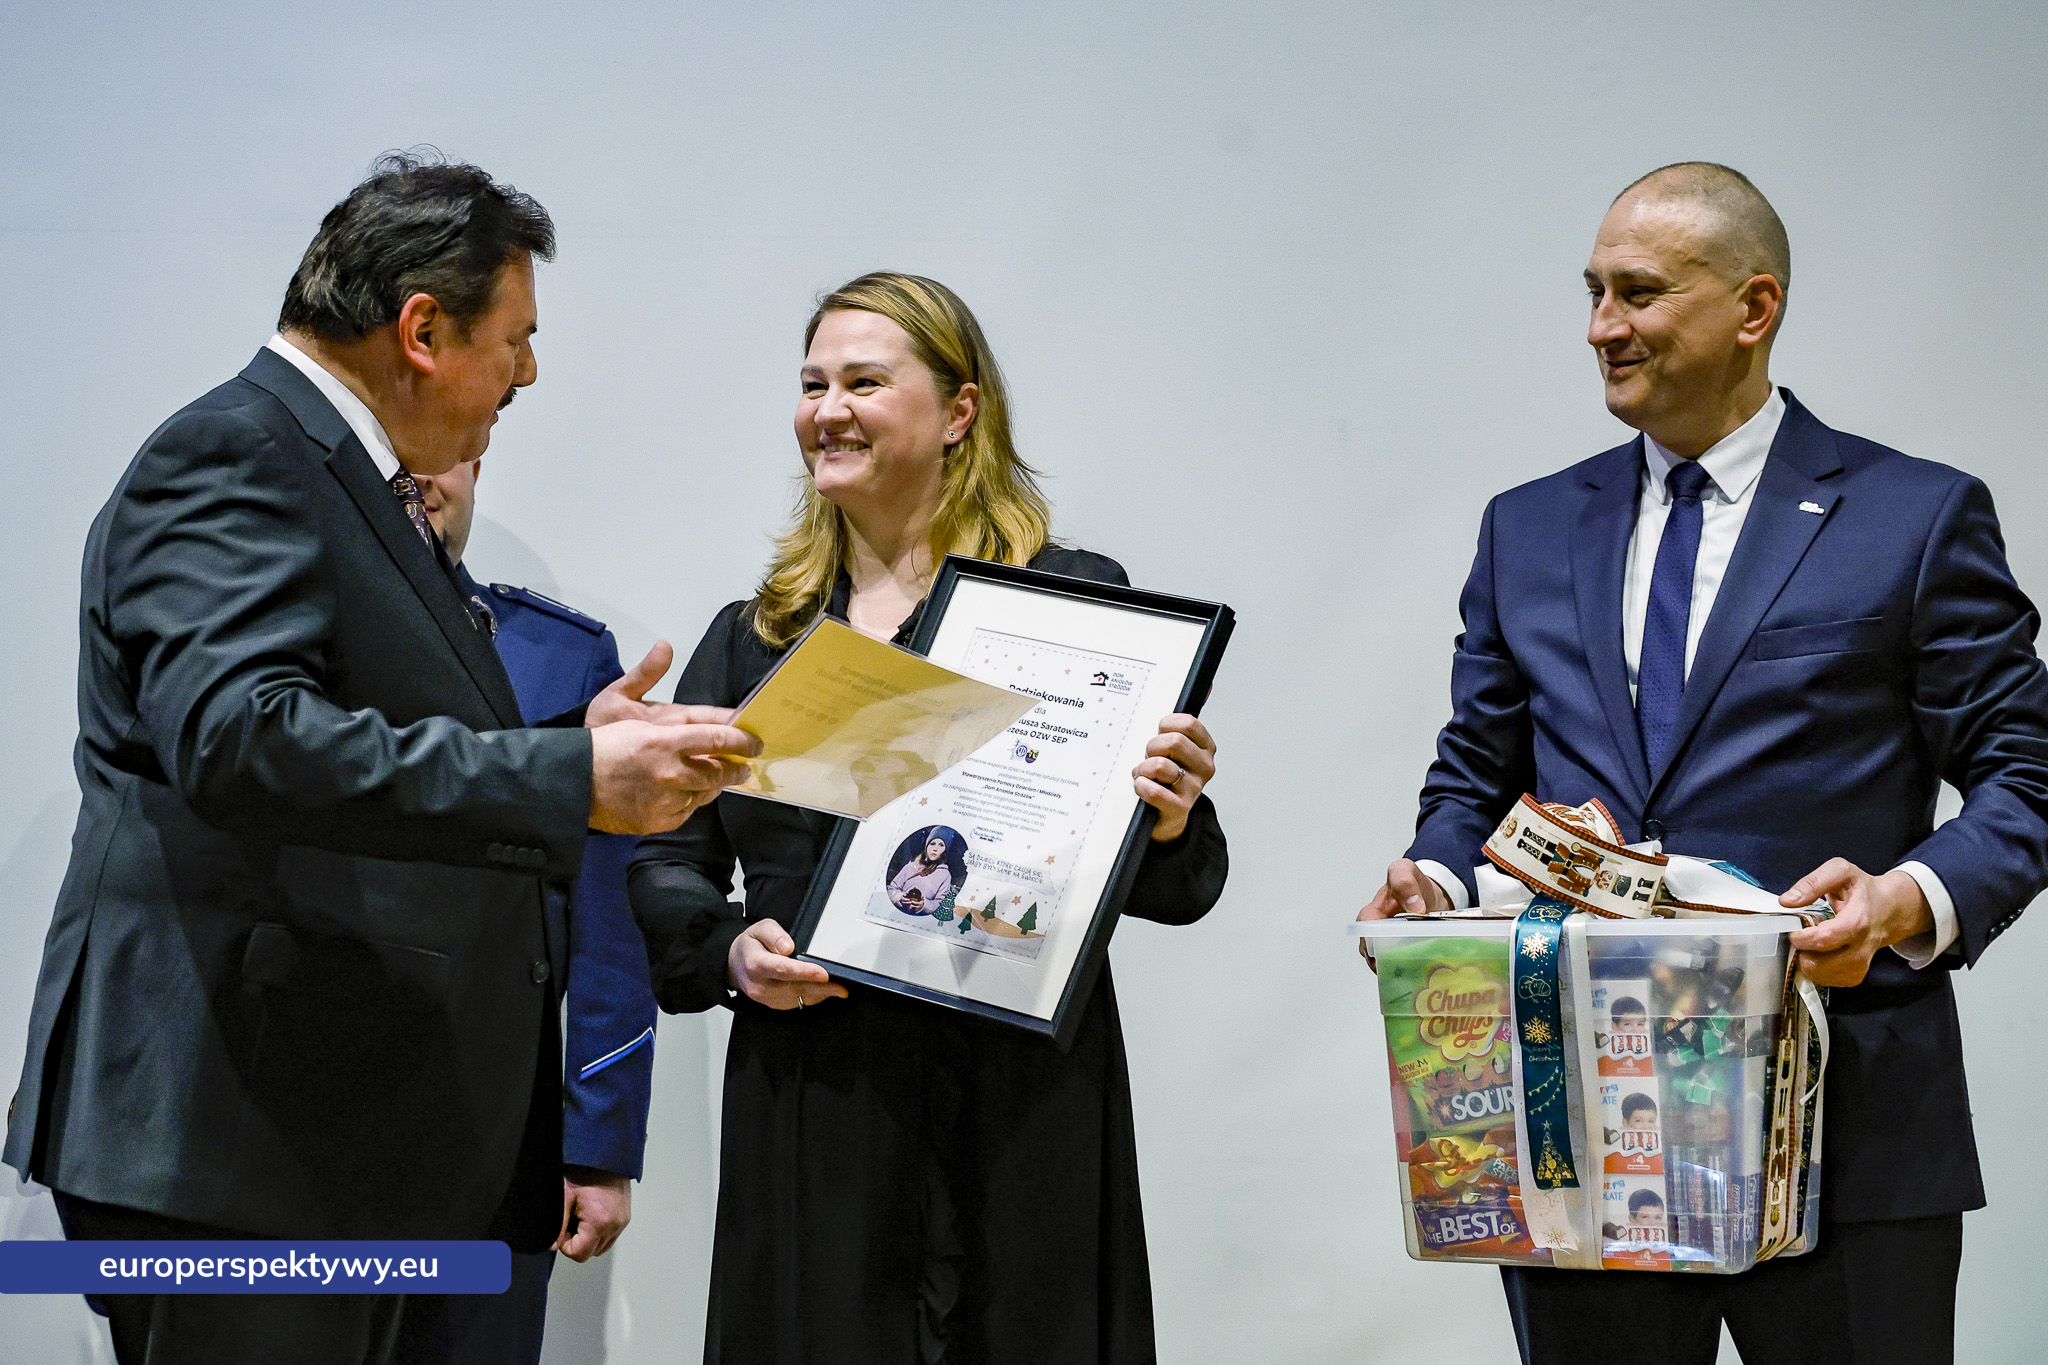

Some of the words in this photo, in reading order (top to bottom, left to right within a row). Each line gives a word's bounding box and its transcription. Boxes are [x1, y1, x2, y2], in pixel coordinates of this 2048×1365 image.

[1034, 706, 1047, 716] dla
[1030, 730, 1051, 741] OZW
[1051, 735, 1068, 744] SEP
[1040, 722, 1089, 739] Saratowicza
[997, 779, 1015, 788] Pomocy
[1016, 783, 1037, 792] Dzieciom
[1426, 988, 1496, 1014] Chupa
[1428, 1013, 1494, 1048] Chups
[1398, 1062, 1415, 1074] NEW
[1451, 1085, 1515, 1121] SOUR
[1493, 1158, 1518, 1178] PAPE
[1440, 1210, 1501, 1242] BEST
[1500, 1222, 1517, 1234] OF
